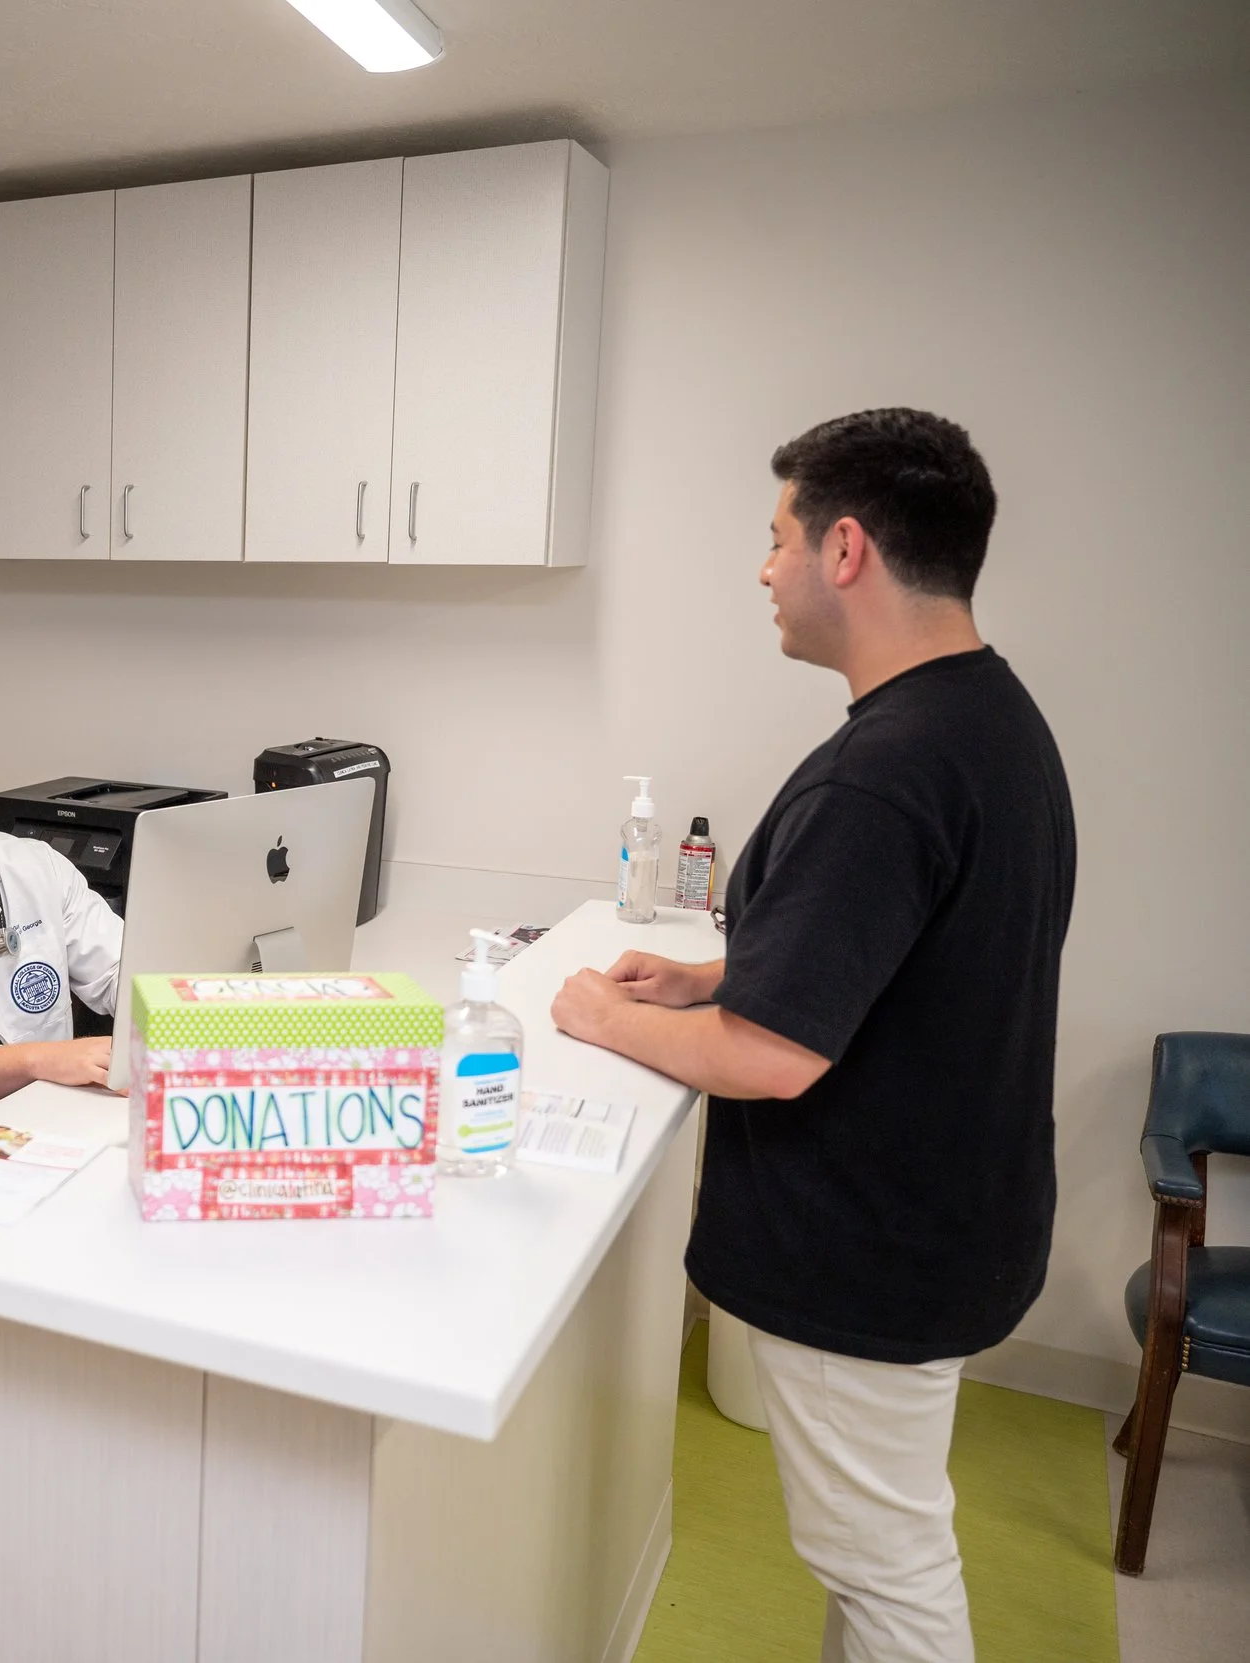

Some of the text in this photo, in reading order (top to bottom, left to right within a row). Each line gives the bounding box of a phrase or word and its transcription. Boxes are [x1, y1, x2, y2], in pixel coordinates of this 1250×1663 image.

[57, 810, 76, 818] EPSON
[22, 919, 43, 932] Georgia
[17, 965, 36, 979] COLLEGE
[42, 966, 57, 983] GEORGIA
[476, 1084, 504, 1095] HAND
[462, 1092, 514, 1108] SANITIZER
[169, 1084, 425, 1151] DONATIONS
